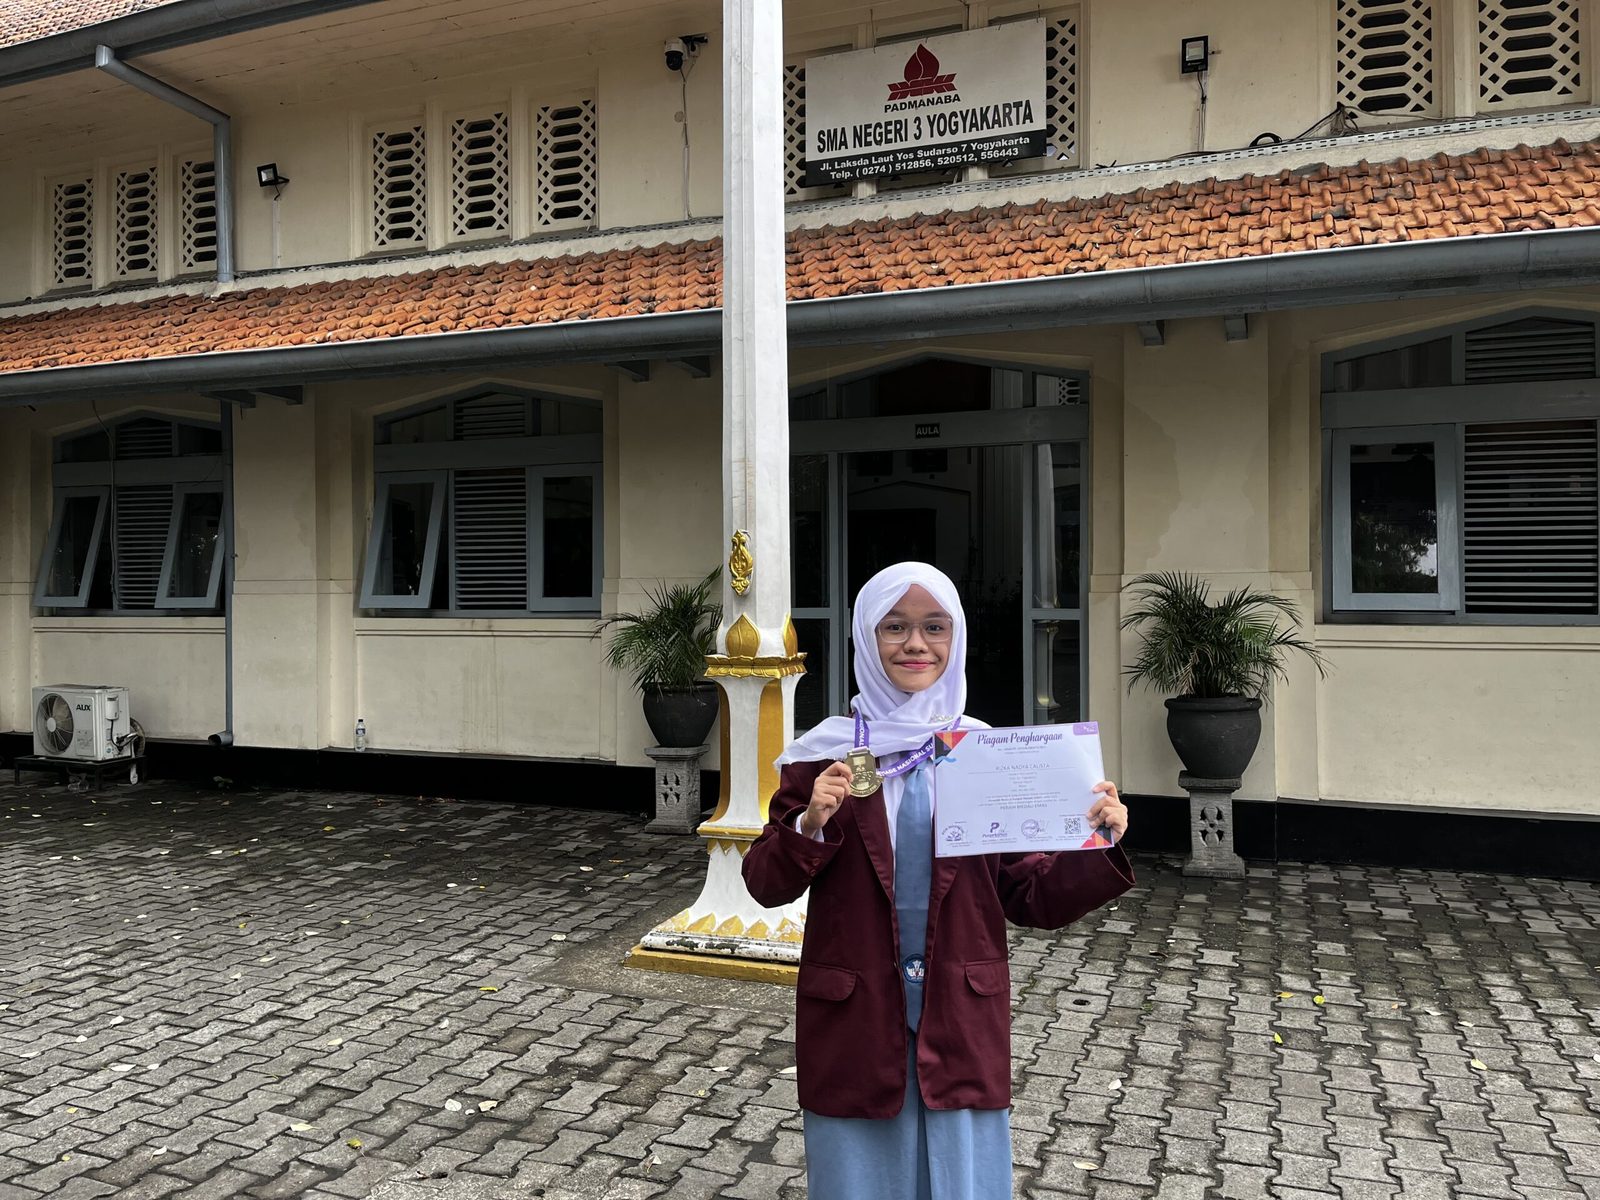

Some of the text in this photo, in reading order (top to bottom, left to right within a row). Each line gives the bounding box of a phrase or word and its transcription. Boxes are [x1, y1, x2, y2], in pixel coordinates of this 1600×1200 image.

[884, 94, 961, 113] PADMANABA
[817, 100, 1034, 153] SMA NEGERI 3 YOGYAKARTA
[835, 157, 869, 169] Laksda
[872, 154, 894, 164] Laut
[897, 152, 914, 161] Yos
[917, 146, 958, 158] Sudarso
[961, 144, 967, 152] 7
[970, 136, 1030, 151] Yogyakarta
[830, 170, 853, 180] Telp.
[895, 158, 935, 171] 512856,
[937, 153, 978, 166] 520512,
[980, 147, 1019, 160] 556443
[917, 426, 939, 435] AULA
[977, 731, 1063, 747] Piagam Penghargaan
[896, 750, 926, 770] NASIONAL
